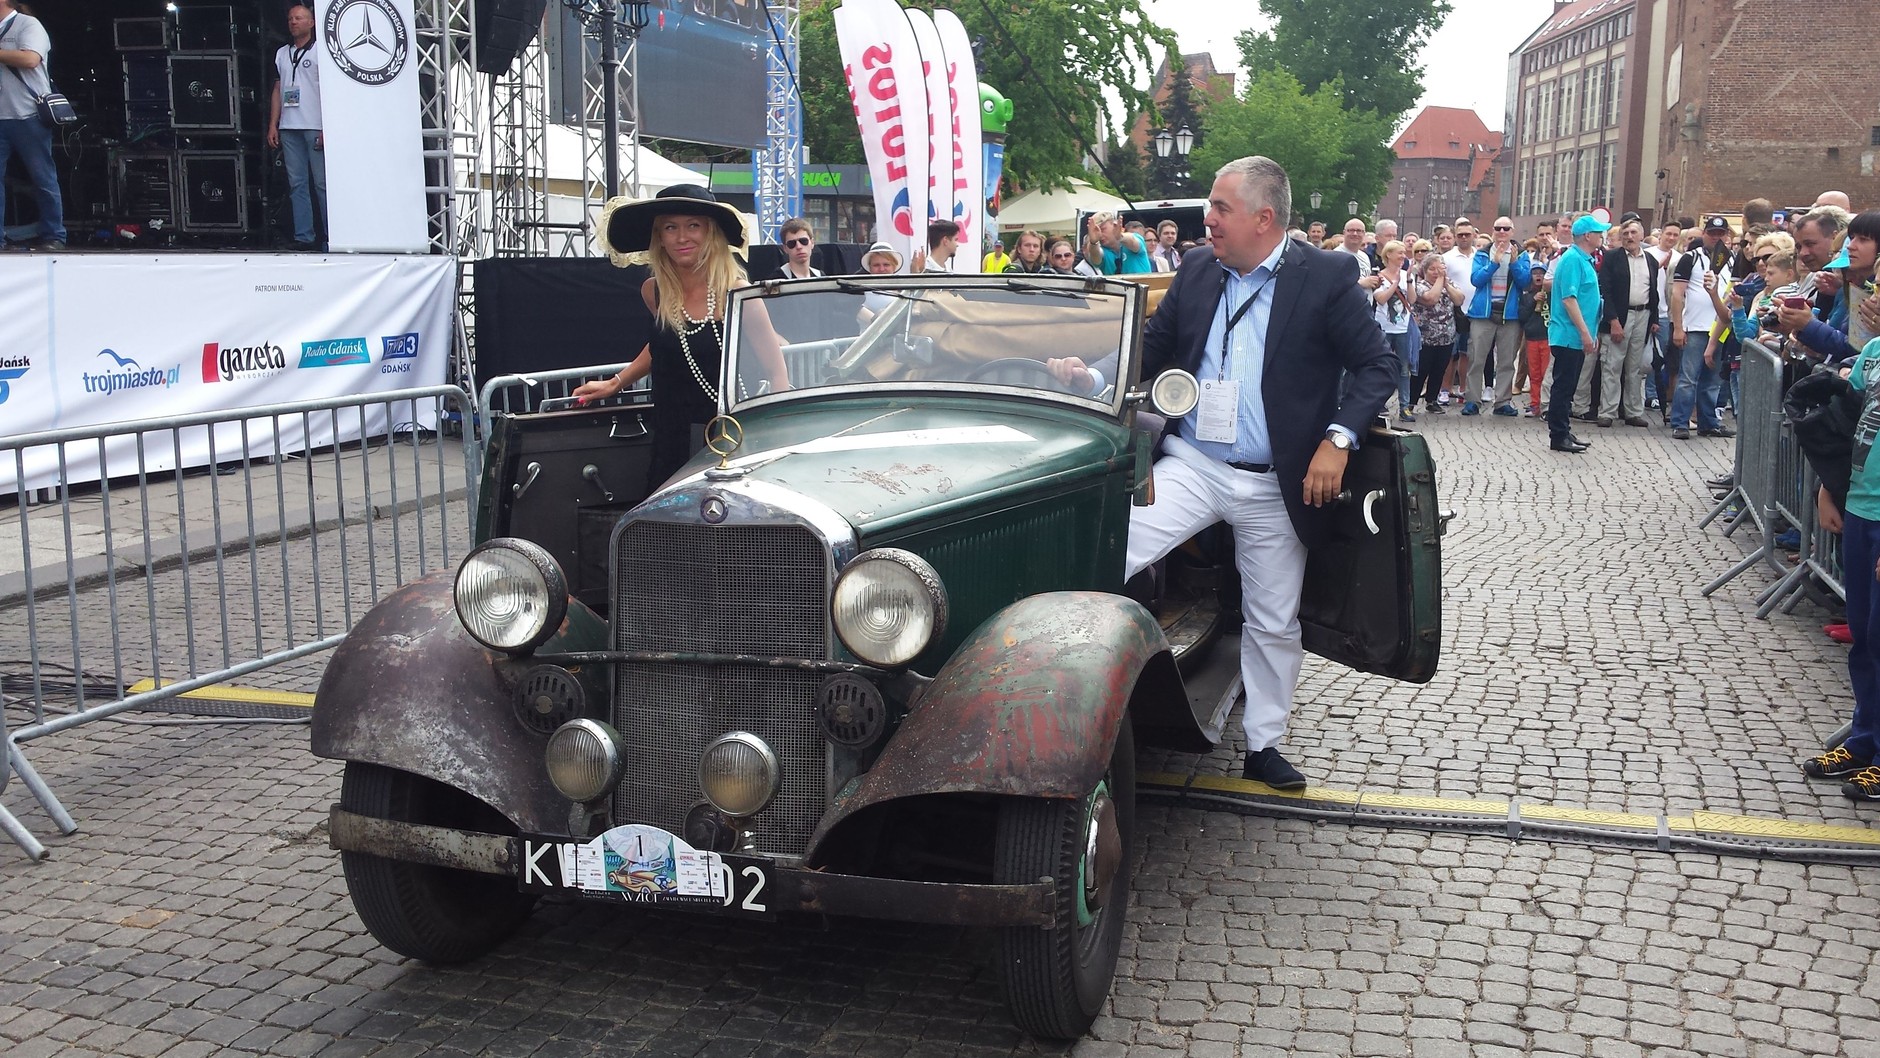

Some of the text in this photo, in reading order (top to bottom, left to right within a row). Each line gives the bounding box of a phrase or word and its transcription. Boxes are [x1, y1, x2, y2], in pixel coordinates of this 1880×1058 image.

[327, 12, 337, 32] KLUB
[356, 71, 384, 82] POLSKA
[802, 172, 841, 187] RUCH
[254, 284, 277, 292] PATRONI
[305, 340, 364, 358] Radio Gdańsk
[406, 336, 417, 354] 3
[219, 340, 286, 381] gazeta
[381, 361, 411, 374] GDAŃSK
[83, 363, 181, 396] trojmiasto.pl
[636, 834, 643, 857] 1
